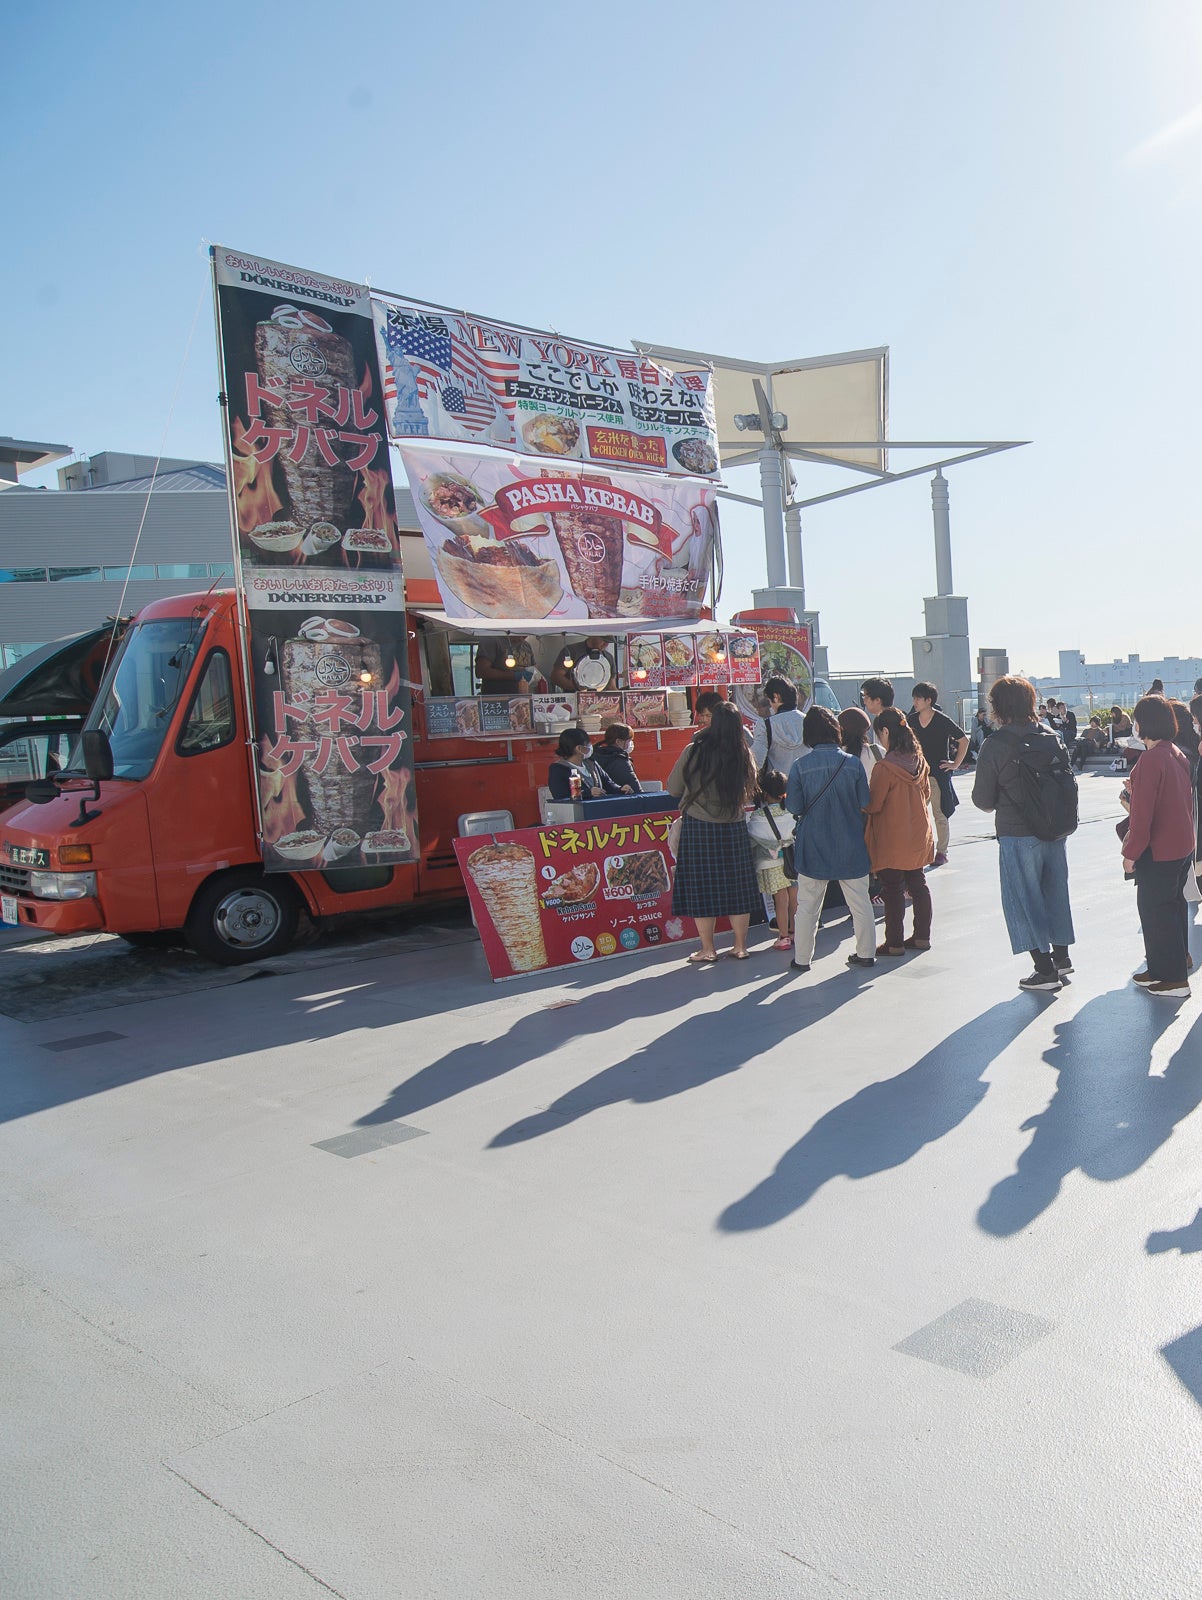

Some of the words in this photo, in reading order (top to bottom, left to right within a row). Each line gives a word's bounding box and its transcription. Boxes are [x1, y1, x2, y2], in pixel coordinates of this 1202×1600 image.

[240, 271, 356, 307] DÖNERKEBAP
[297, 362, 320, 371] HALAL
[453, 319, 521, 358] NEW
[529, 339, 616, 378] YORK
[616, 359, 706, 391] 屋台理
[526, 363, 619, 396] ここでしか
[244, 372, 379, 429] ドネル
[510, 382, 621, 412] チーズチキンオーバーライス
[518, 400, 624, 425] 特製ヨーグルトソース使用
[242, 418, 383, 472] ケバブ
[506, 484, 581, 512] PASHA
[582, 486, 655, 526] KEBAB
[268, 592, 387, 604] DÖNERKEBAP
[273, 690, 404, 733] ドネル
[579, 696, 620, 704] ドネルケバブ
[626, 695, 664, 703] ドネルケバブ
[268, 730, 408, 777] ケバブ
[538, 815, 673, 858] ドネルケバブ
[12, 848, 45, 866] 高圧ガス
[604, 886, 633, 898] ¥600
[557, 904, 580, 916] Kebab
[579, 902, 597, 912] Sand
[562, 912, 596, 923] ケバブサンド
[610, 916, 637, 928] ソース
[639, 911, 663, 922] sauce
